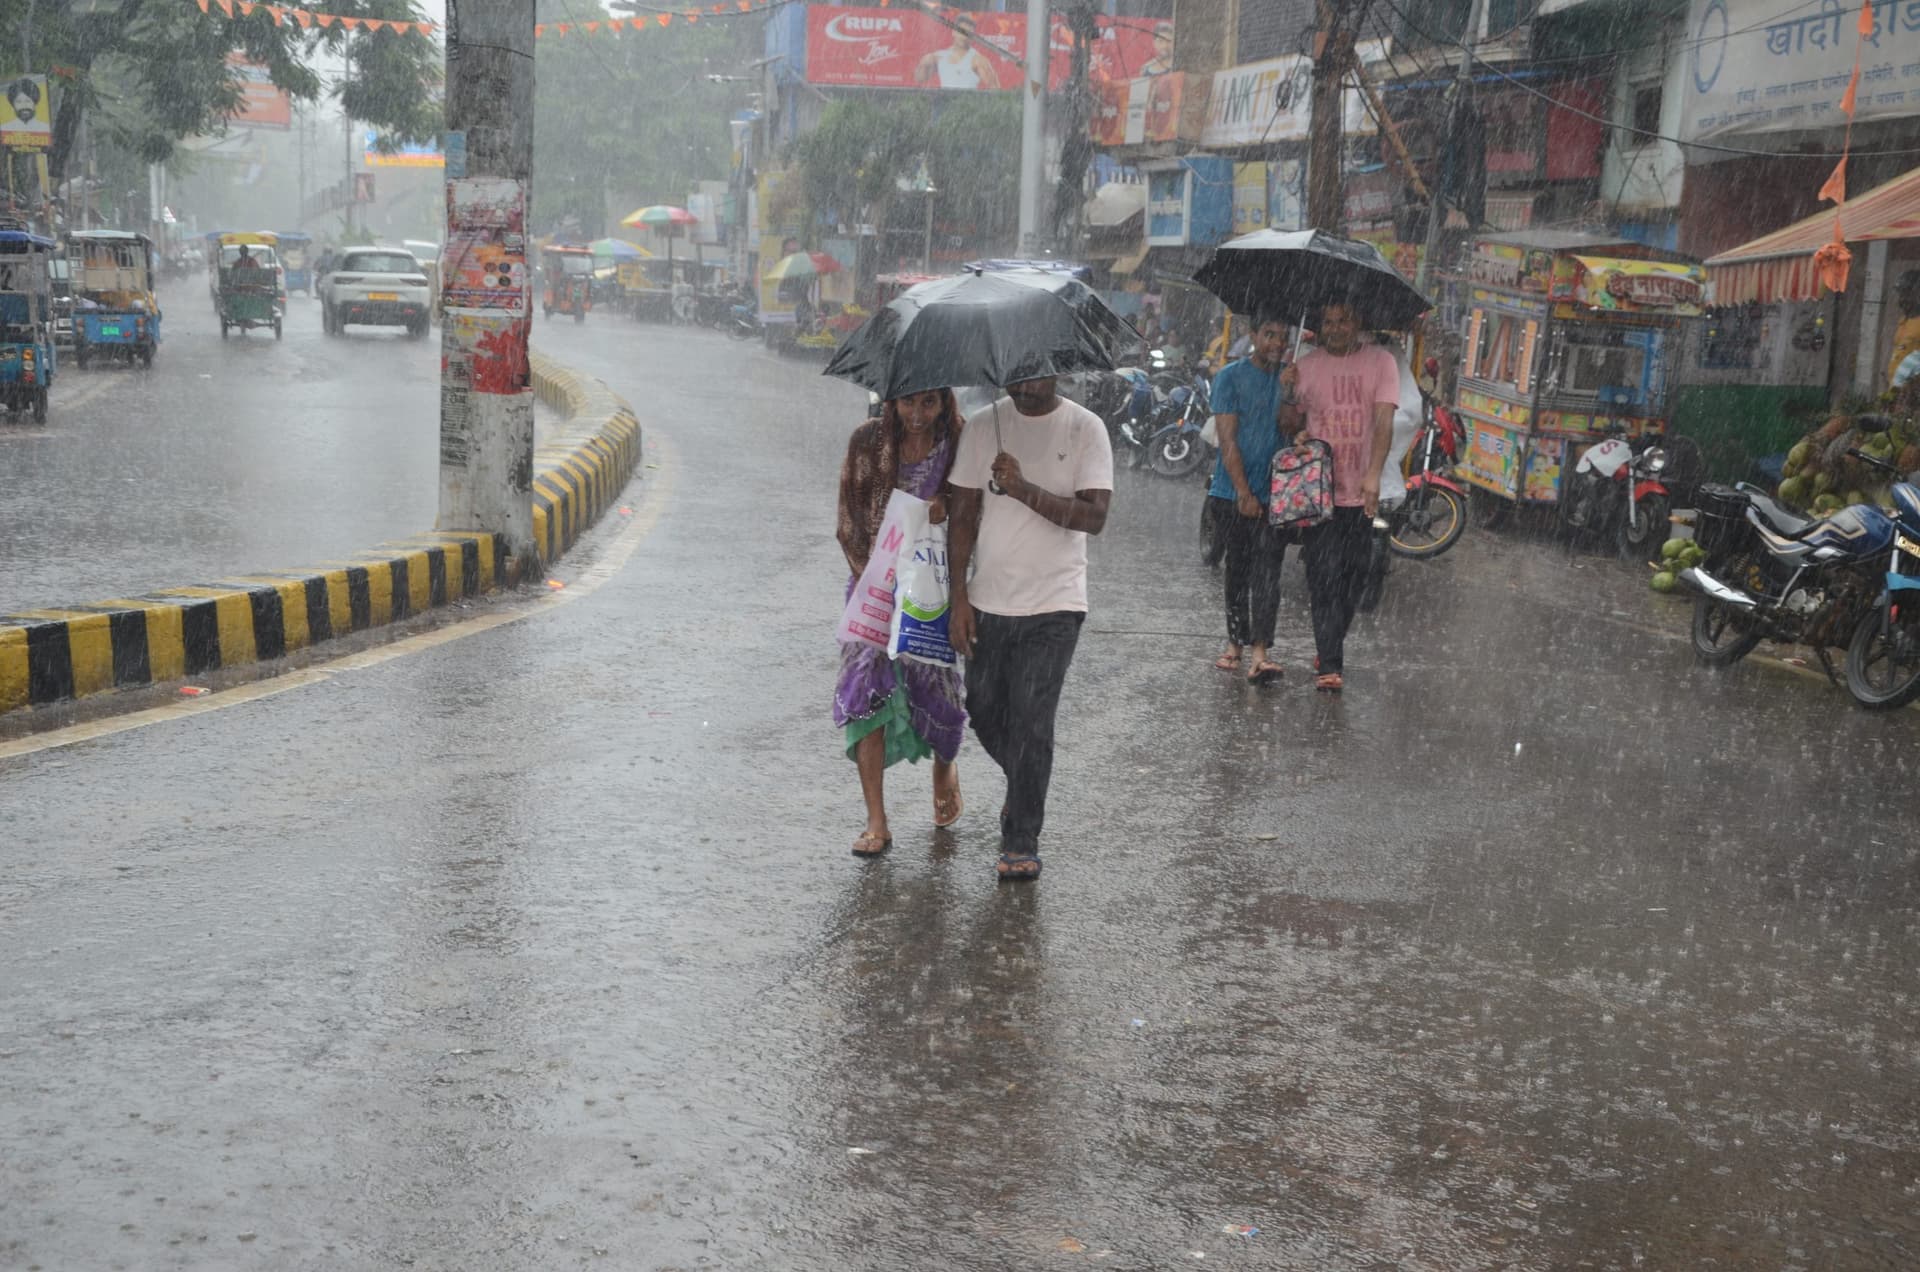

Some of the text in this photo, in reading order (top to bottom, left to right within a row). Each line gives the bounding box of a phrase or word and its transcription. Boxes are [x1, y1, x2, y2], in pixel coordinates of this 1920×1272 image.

[845, 16, 903, 32] RUPA
[1765, 0, 1845, 56] खादी
[1332, 375, 1363, 405] UN
